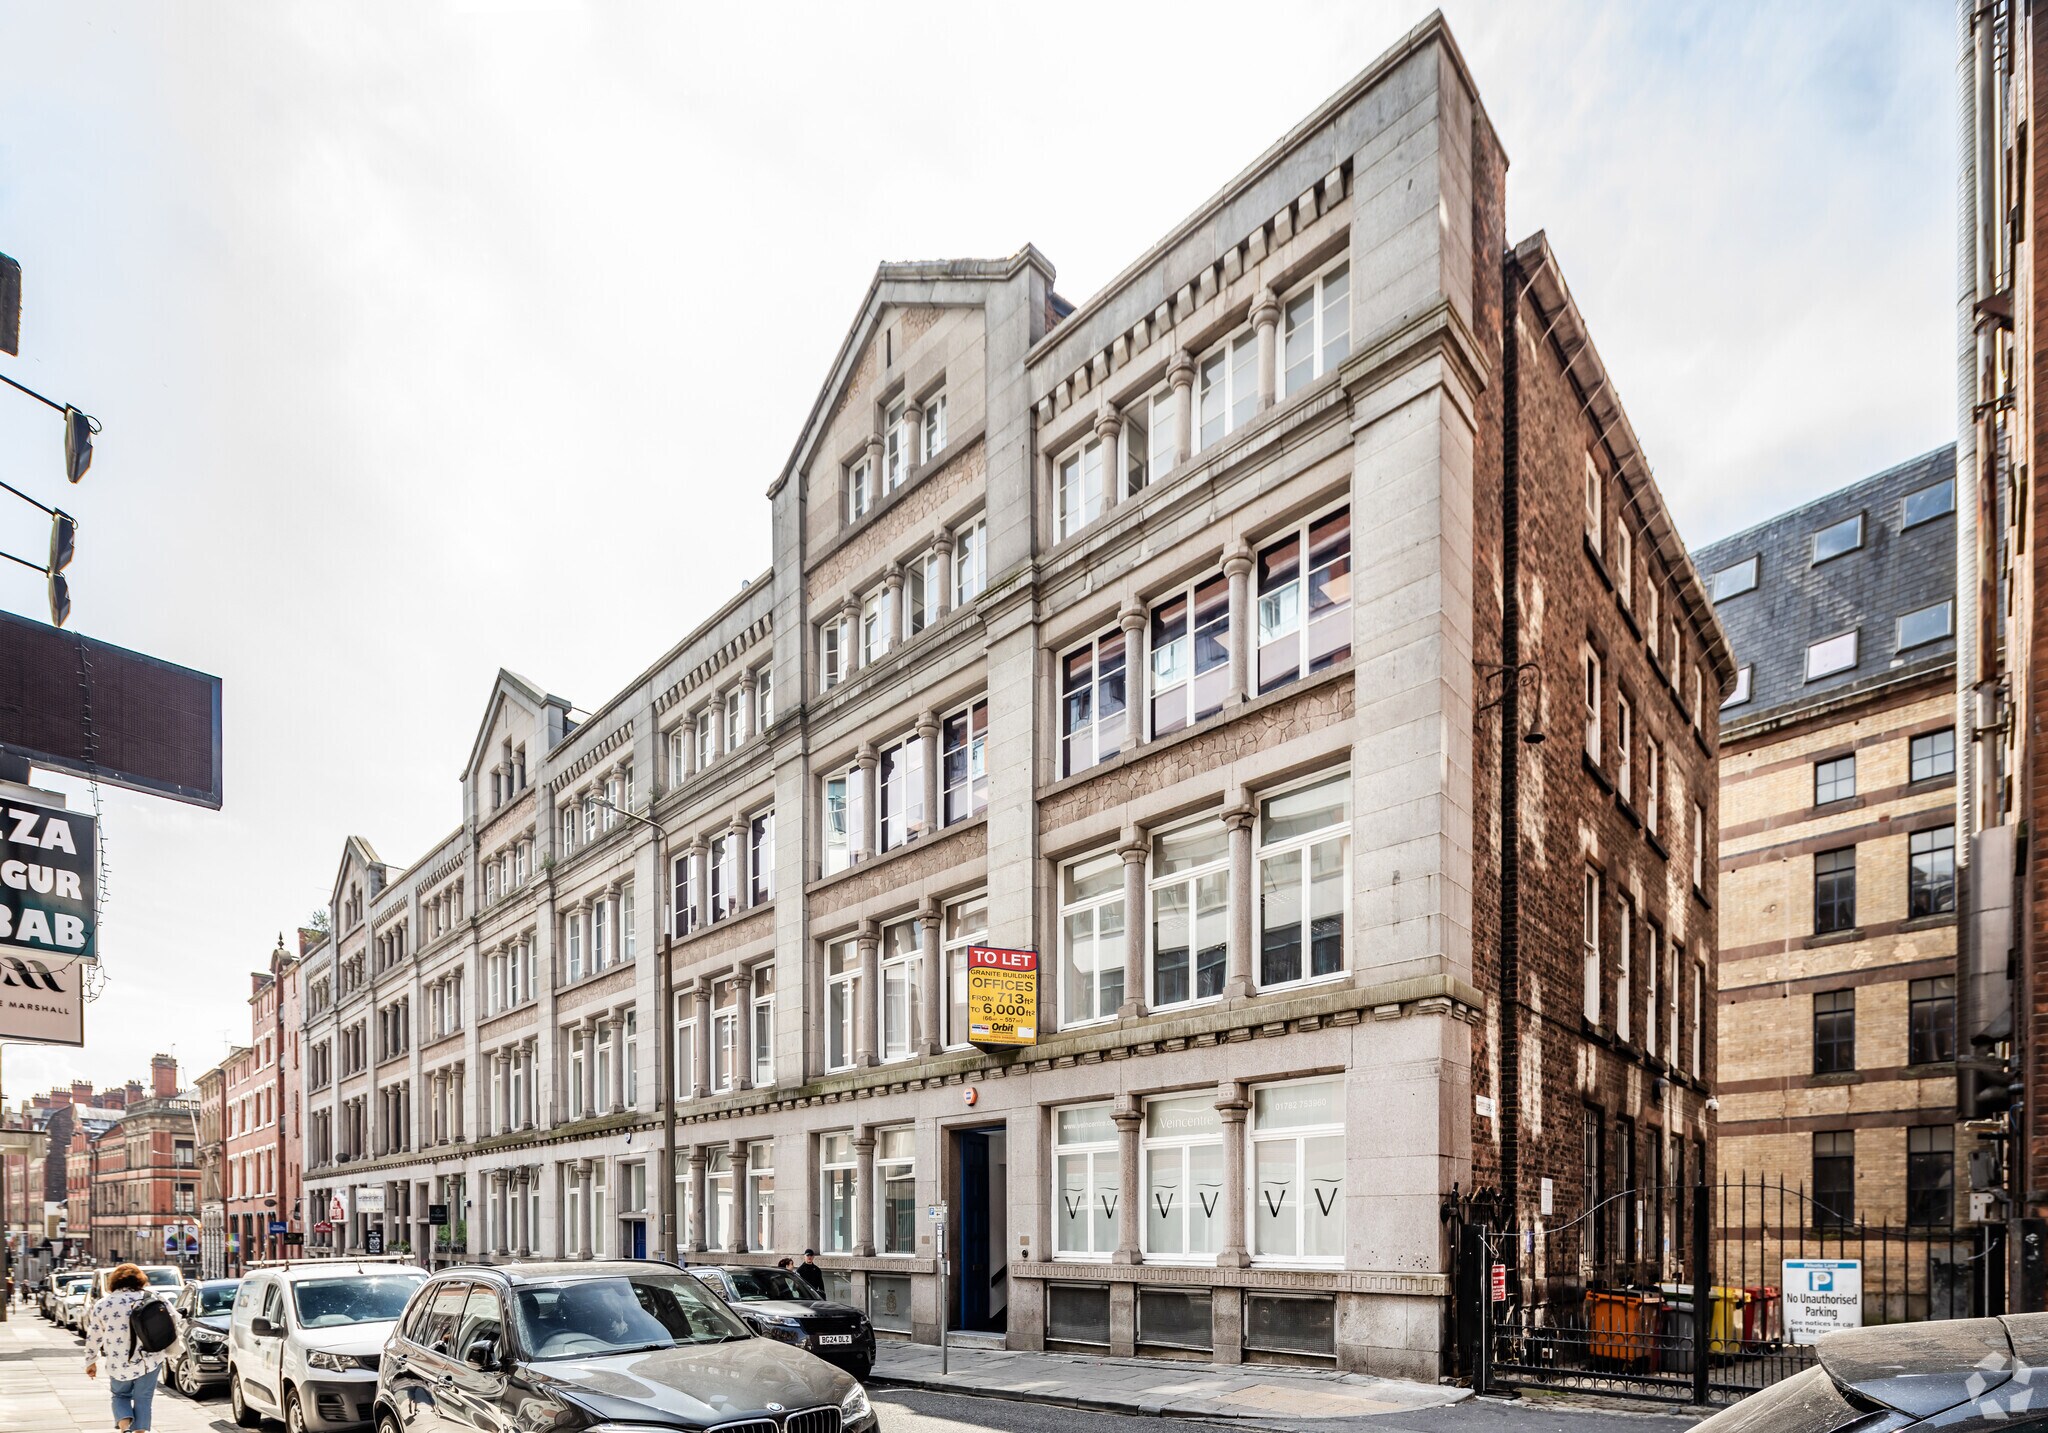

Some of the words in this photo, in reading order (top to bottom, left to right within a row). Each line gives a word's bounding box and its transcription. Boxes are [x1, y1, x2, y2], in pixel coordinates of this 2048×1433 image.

[0, 806, 77, 855] ZA
[0, 859, 83, 901] GUR
[974, 950, 997, 964] TO
[1002, 953, 1032, 967] LET
[970, 969, 1001, 978] GRANITE
[1002, 972, 1035, 980] BUILDING
[972, 977, 1034, 992] OFFICES
[971, 994, 994, 1002] FROM
[9, 1001, 70, 1015] MARSHALL
[991, 1022, 1014, 1031] Orbit
[1275, 1101, 1298, 1111] 01782
[1159, 1115, 1214, 1129] Veincentre
[1786, 1293, 1798, 1303] No
[1800, 1293, 1858, 1305] Unauthorised
[1805, 1306, 1838, 1320] Parking
[1805, 1327, 1816, 1335] for
